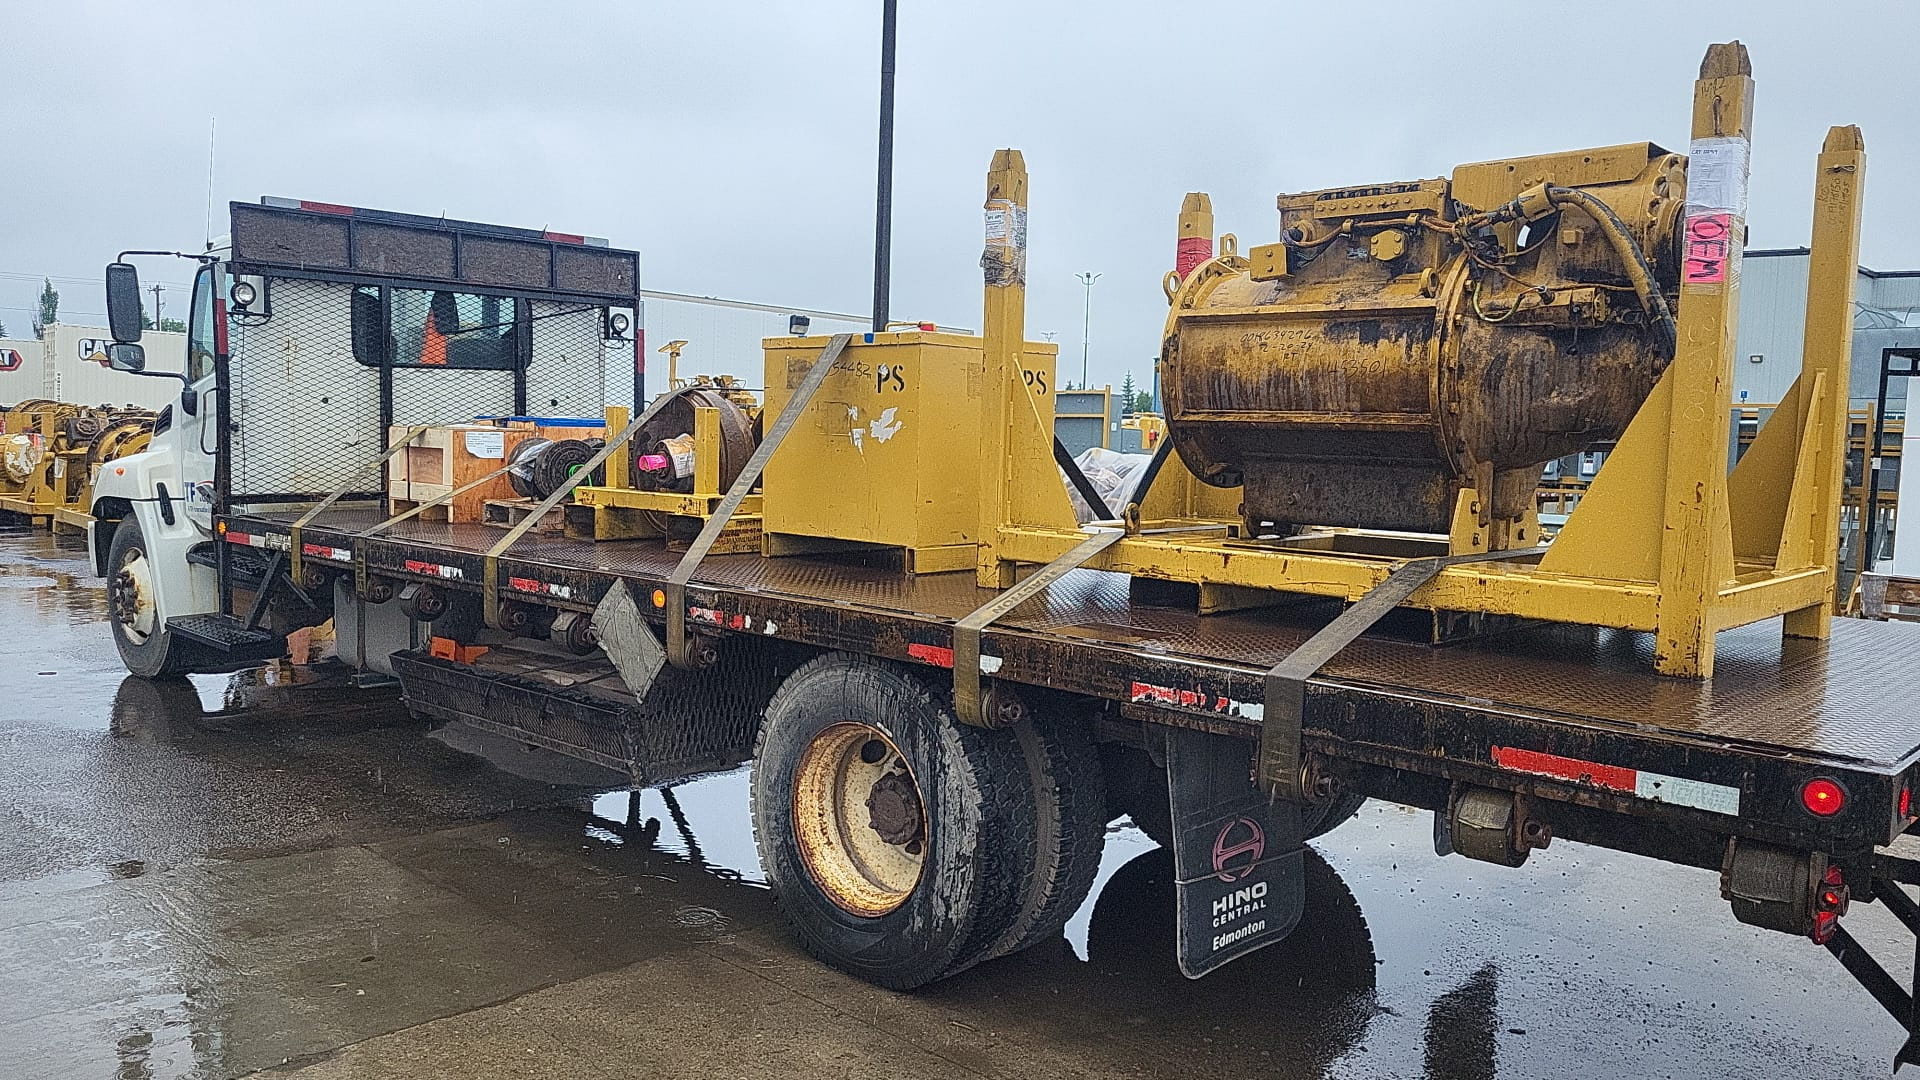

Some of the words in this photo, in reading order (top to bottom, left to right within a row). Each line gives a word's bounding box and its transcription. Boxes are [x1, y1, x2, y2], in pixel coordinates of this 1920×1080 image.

[1687, 216, 1725, 279] OEM
[877, 363, 905, 394] PS
[1022, 369, 1048, 396] PS
[1212, 881, 1268, 917] HINO
[1212, 898, 1267, 928] CENTRAL
[1212, 919, 1266, 952] Edmonton
